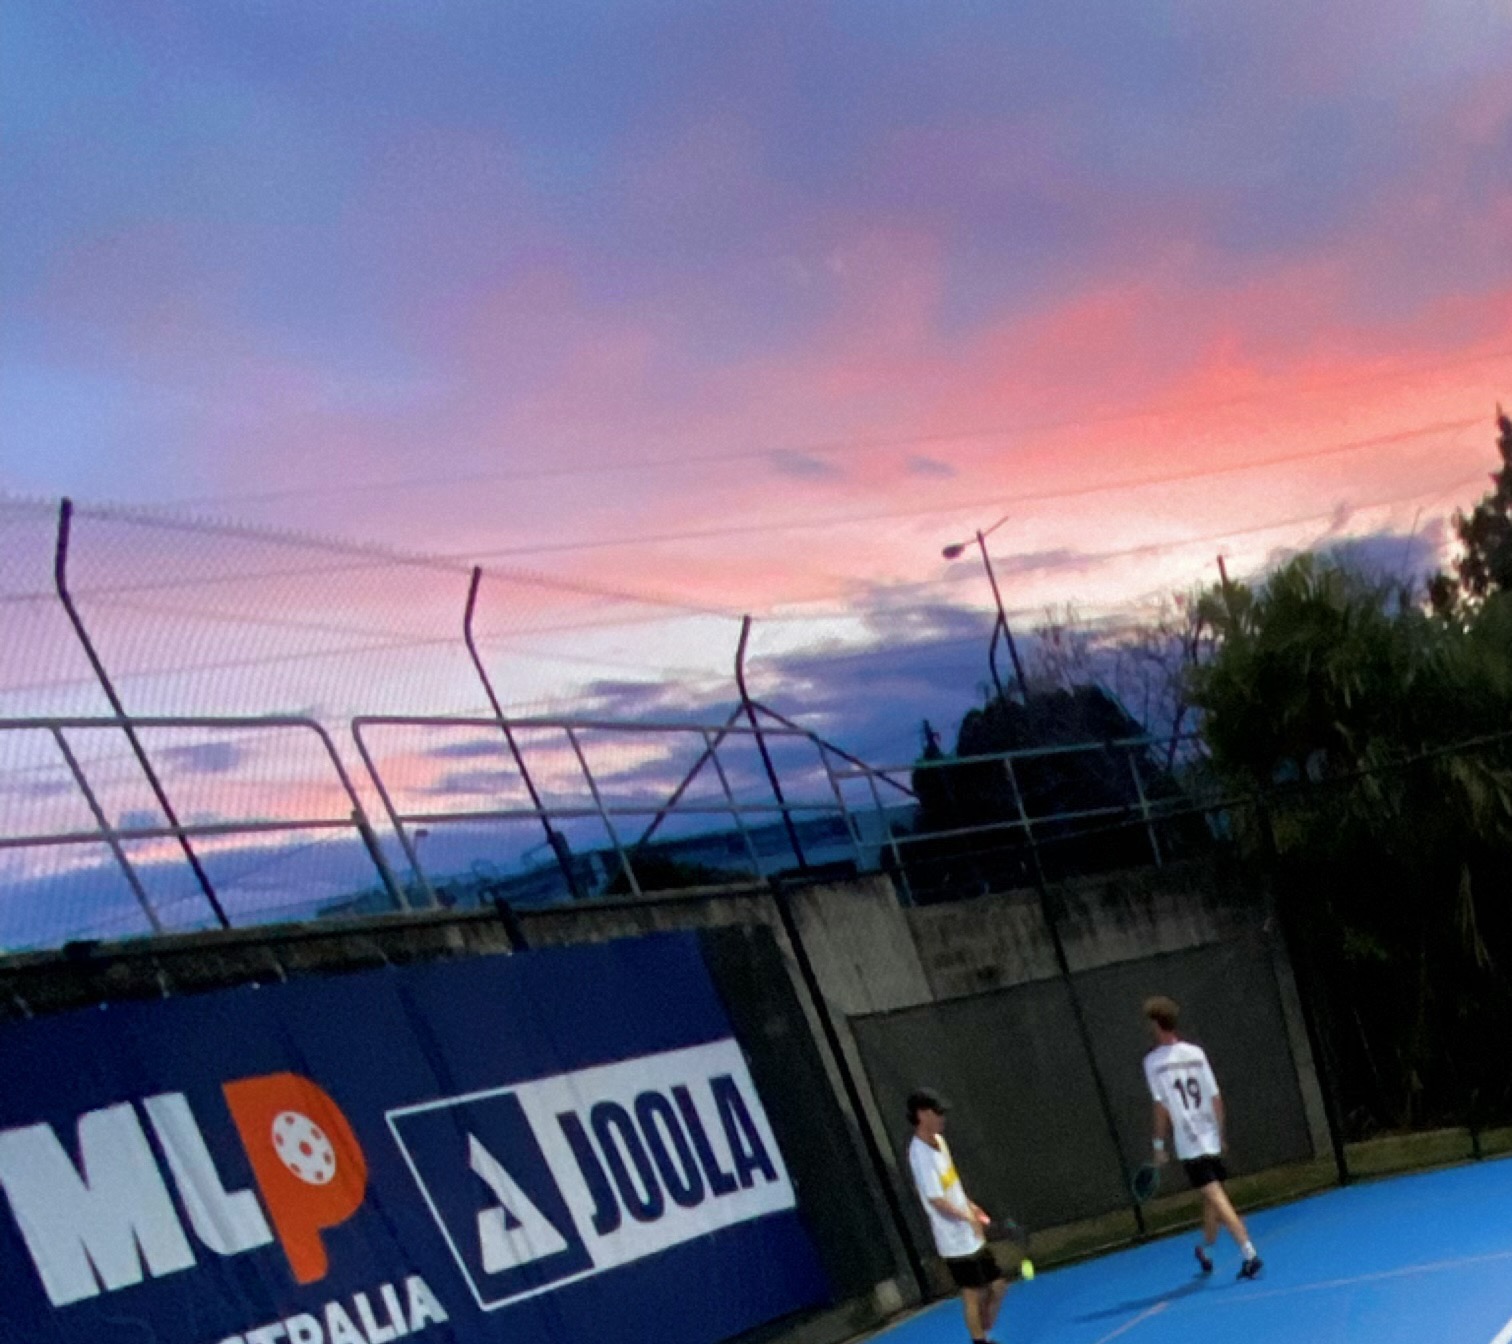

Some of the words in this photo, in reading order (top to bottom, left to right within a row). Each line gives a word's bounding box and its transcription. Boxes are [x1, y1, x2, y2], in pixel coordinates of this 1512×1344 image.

[556, 1073, 779, 1237] JOOLA
[1173, 1077, 1202, 1110] 19
[0, 1072, 368, 1307] MLP
